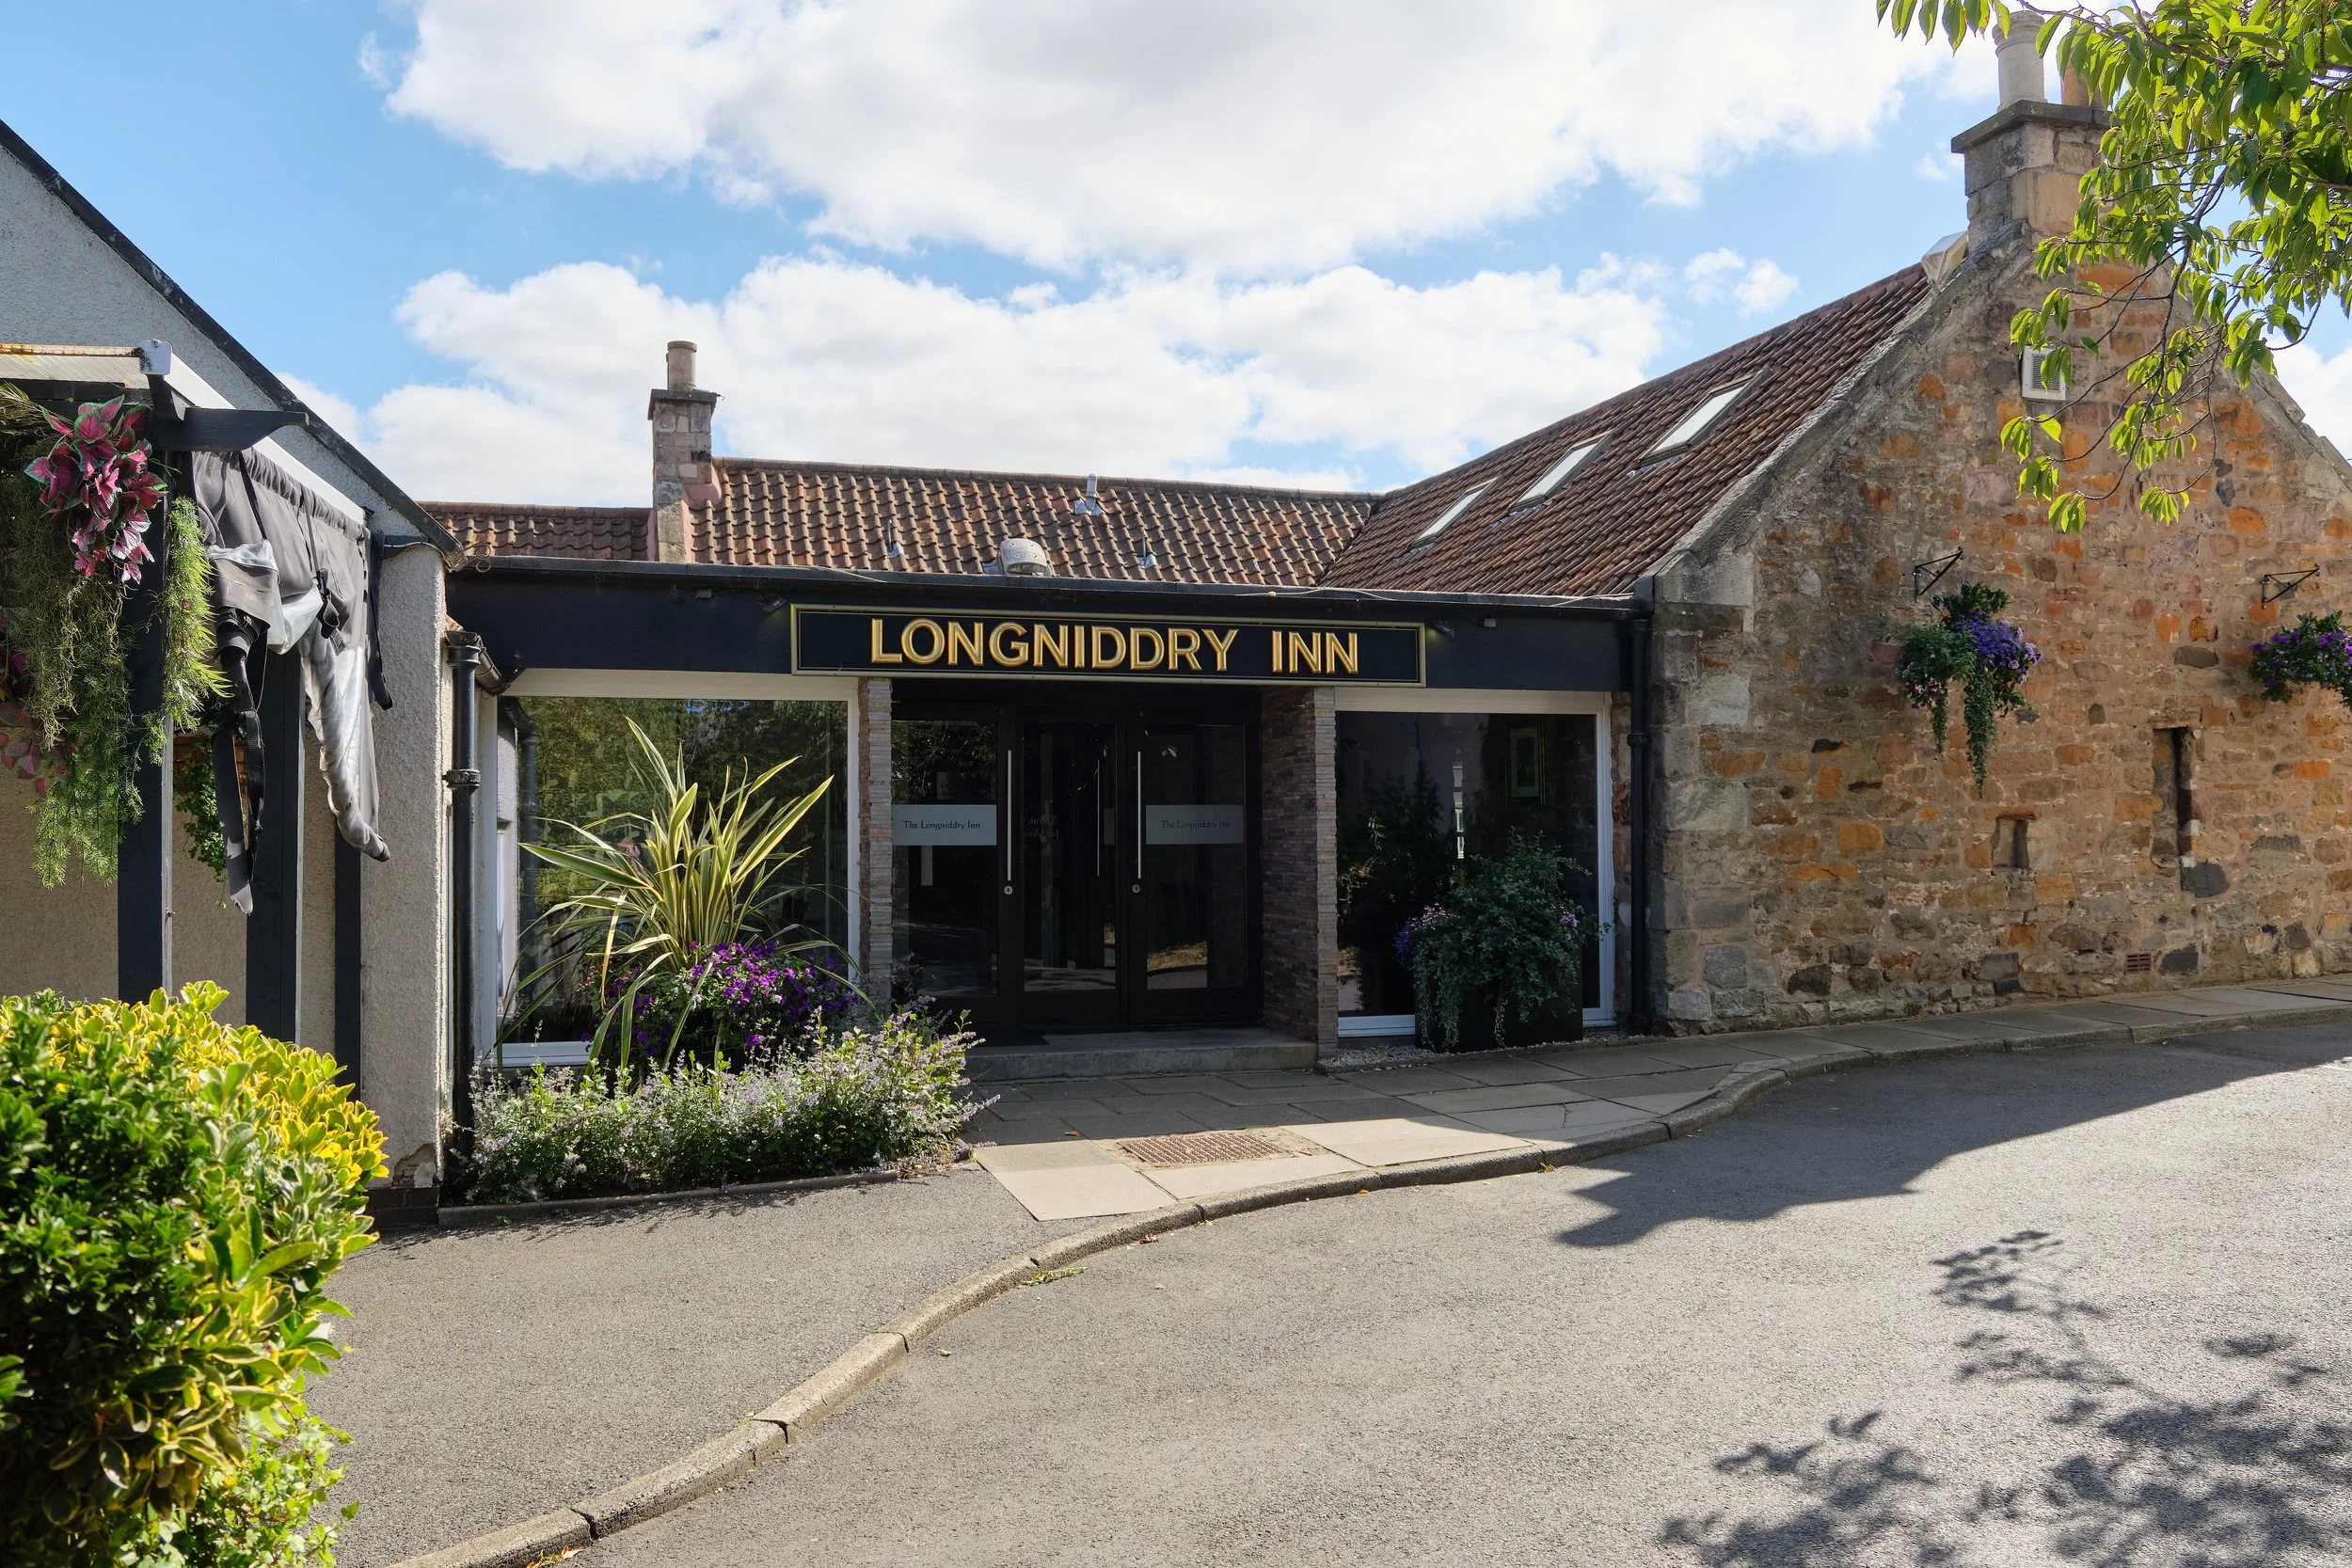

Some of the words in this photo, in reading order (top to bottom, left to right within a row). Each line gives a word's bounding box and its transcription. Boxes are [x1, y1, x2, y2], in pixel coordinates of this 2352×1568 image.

[871, 618, 1237, 671] LONGNIDDRY
[1272, 631, 1359, 673] INN
[902, 820, 919, 829] The
[921, 819, 965, 831] Longniddry
[967, 820, 980, 829] Inn
[1160, 819, 1175, 829] The
